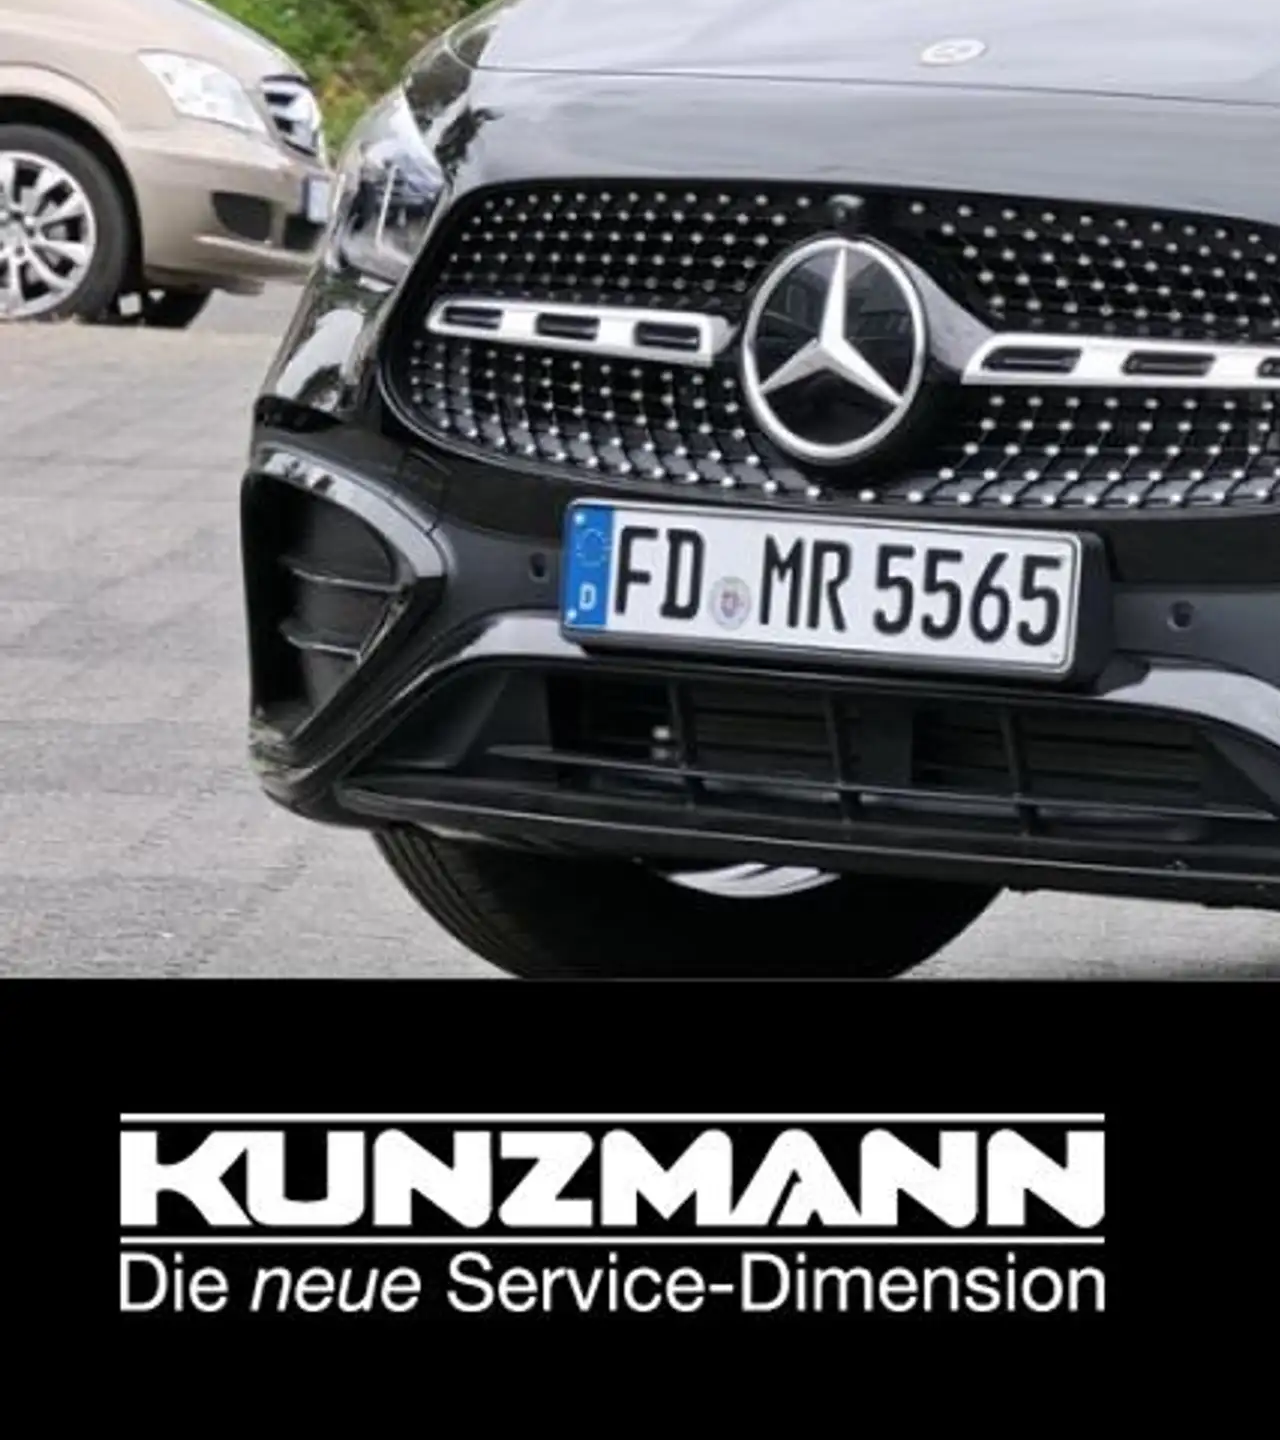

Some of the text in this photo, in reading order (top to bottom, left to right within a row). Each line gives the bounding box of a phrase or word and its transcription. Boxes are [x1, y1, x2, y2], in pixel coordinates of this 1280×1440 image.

[579, 582, 597, 611] D
[616, 525, 1061, 646] FD MR 5565
